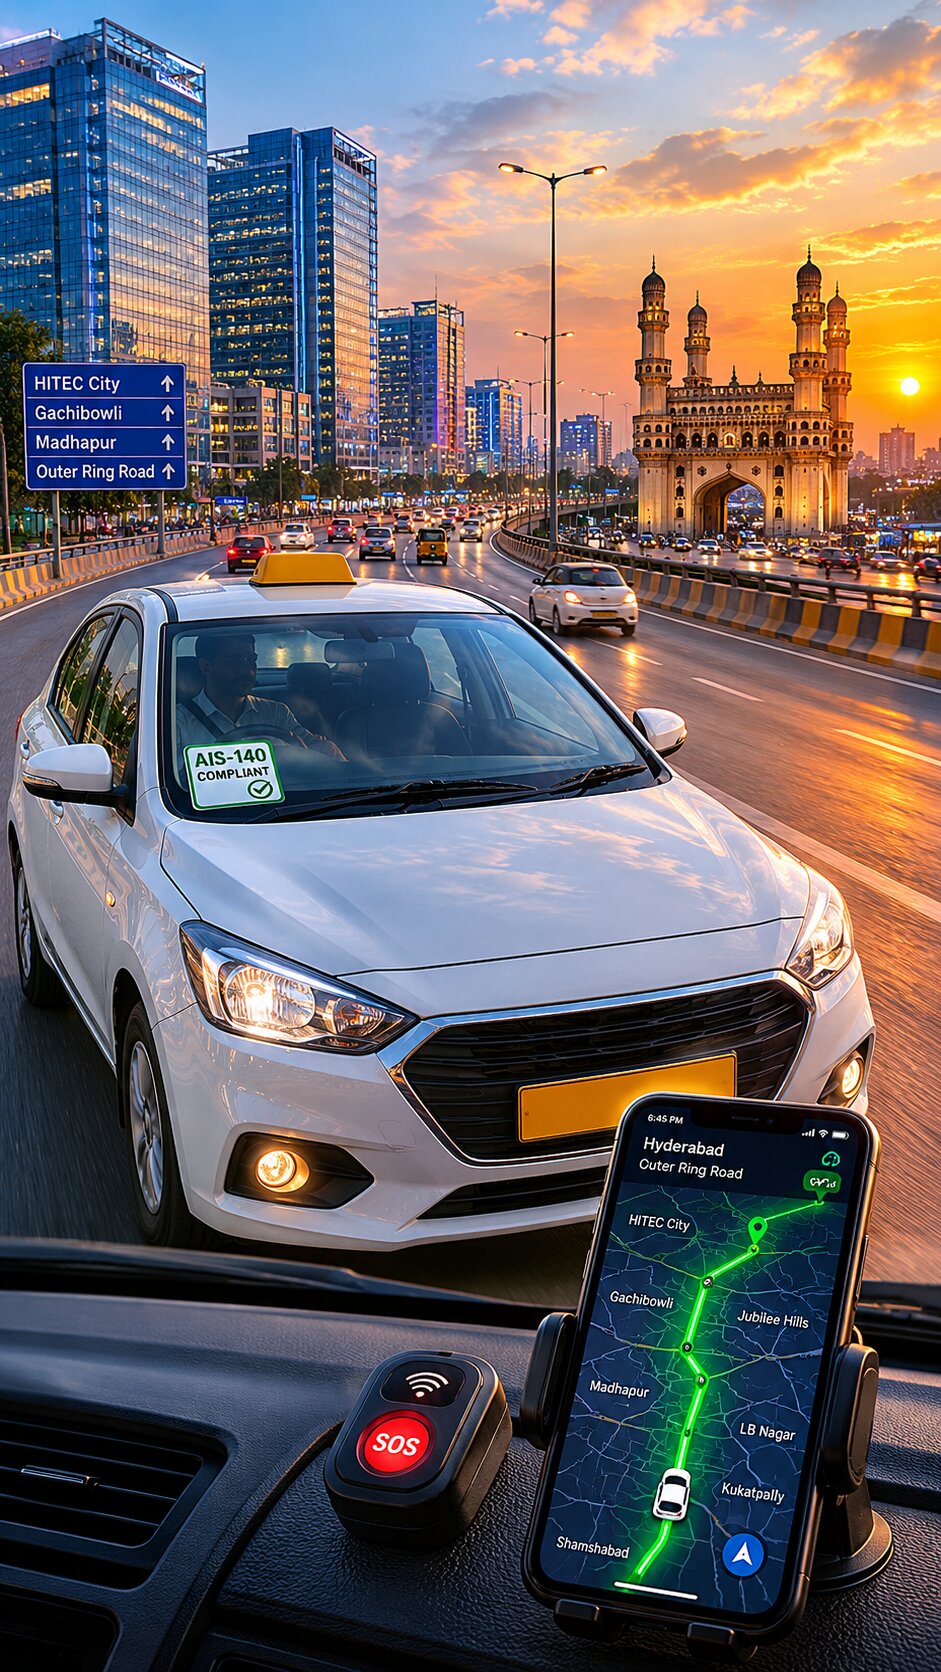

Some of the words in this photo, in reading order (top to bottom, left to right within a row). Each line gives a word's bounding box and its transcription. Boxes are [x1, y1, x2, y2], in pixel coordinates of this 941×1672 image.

[34, 376, 83, 391] HITEC
[88, 375, 121, 394] City
[34, 405, 122, 420] Gachibowli
[35, 435, 117, 453] Madhapur
[36, 464, 78, 479] Outer
[82, 464, 115, 482] Ring
[119, 464, 155, 479] Road
[195, 748, 267, 768] AIS-140
[197, 766, 270, 782] COMPLIANT
[647, 1113, 667, 1123] 6:45
[669, 1115, 684, 1124] PM
[643, 1136, 725, 1157] Hyderabad
[678, 1161, 707, 1179] Ring
[710, 1165, 744, 1179] Road
[628, 1213, 664, 1228] HITEC
[666, 1218, 690, 1233] City
[609, 1290, 674, 1309] Gachibowli
[736, 1309, 780, 1325] Jubilee
[783, 1314, 809, 1329] Hills
[589, 1380, 650, 1399] Madhapur
[739, 1422, 756, 1436] LB
[759, 1425, 796, 1442] Nagar
[372, 1432, 420, 1456] SOS
[721, 1481, 785, 1505] Kukatpally
[556, 1535, 631, 1559] Shamshabad
